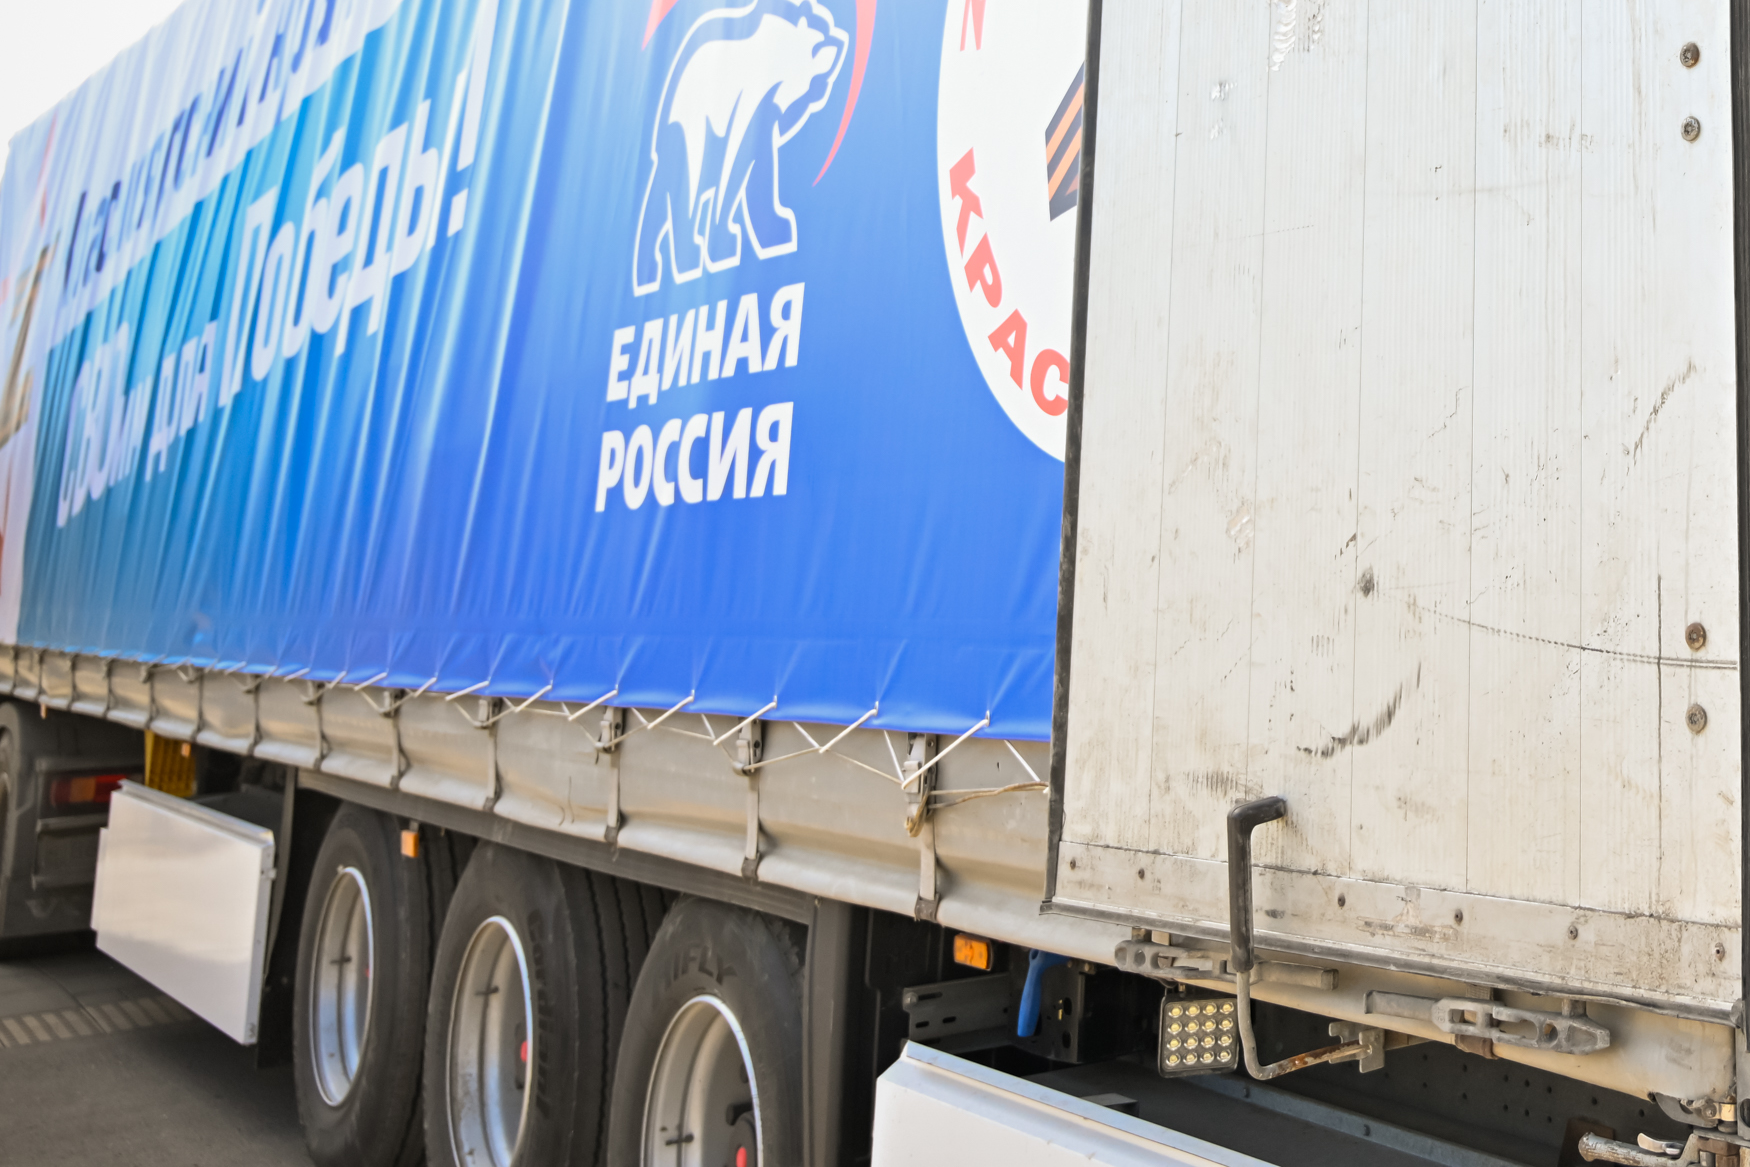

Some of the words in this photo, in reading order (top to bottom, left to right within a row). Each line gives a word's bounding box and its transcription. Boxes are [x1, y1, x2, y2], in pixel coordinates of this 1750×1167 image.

[145, 319, 219, 483] для
[606, 282, 806, 409] ЕДИНАЯ
[595, 401, 794, 513] РОССИЯ
